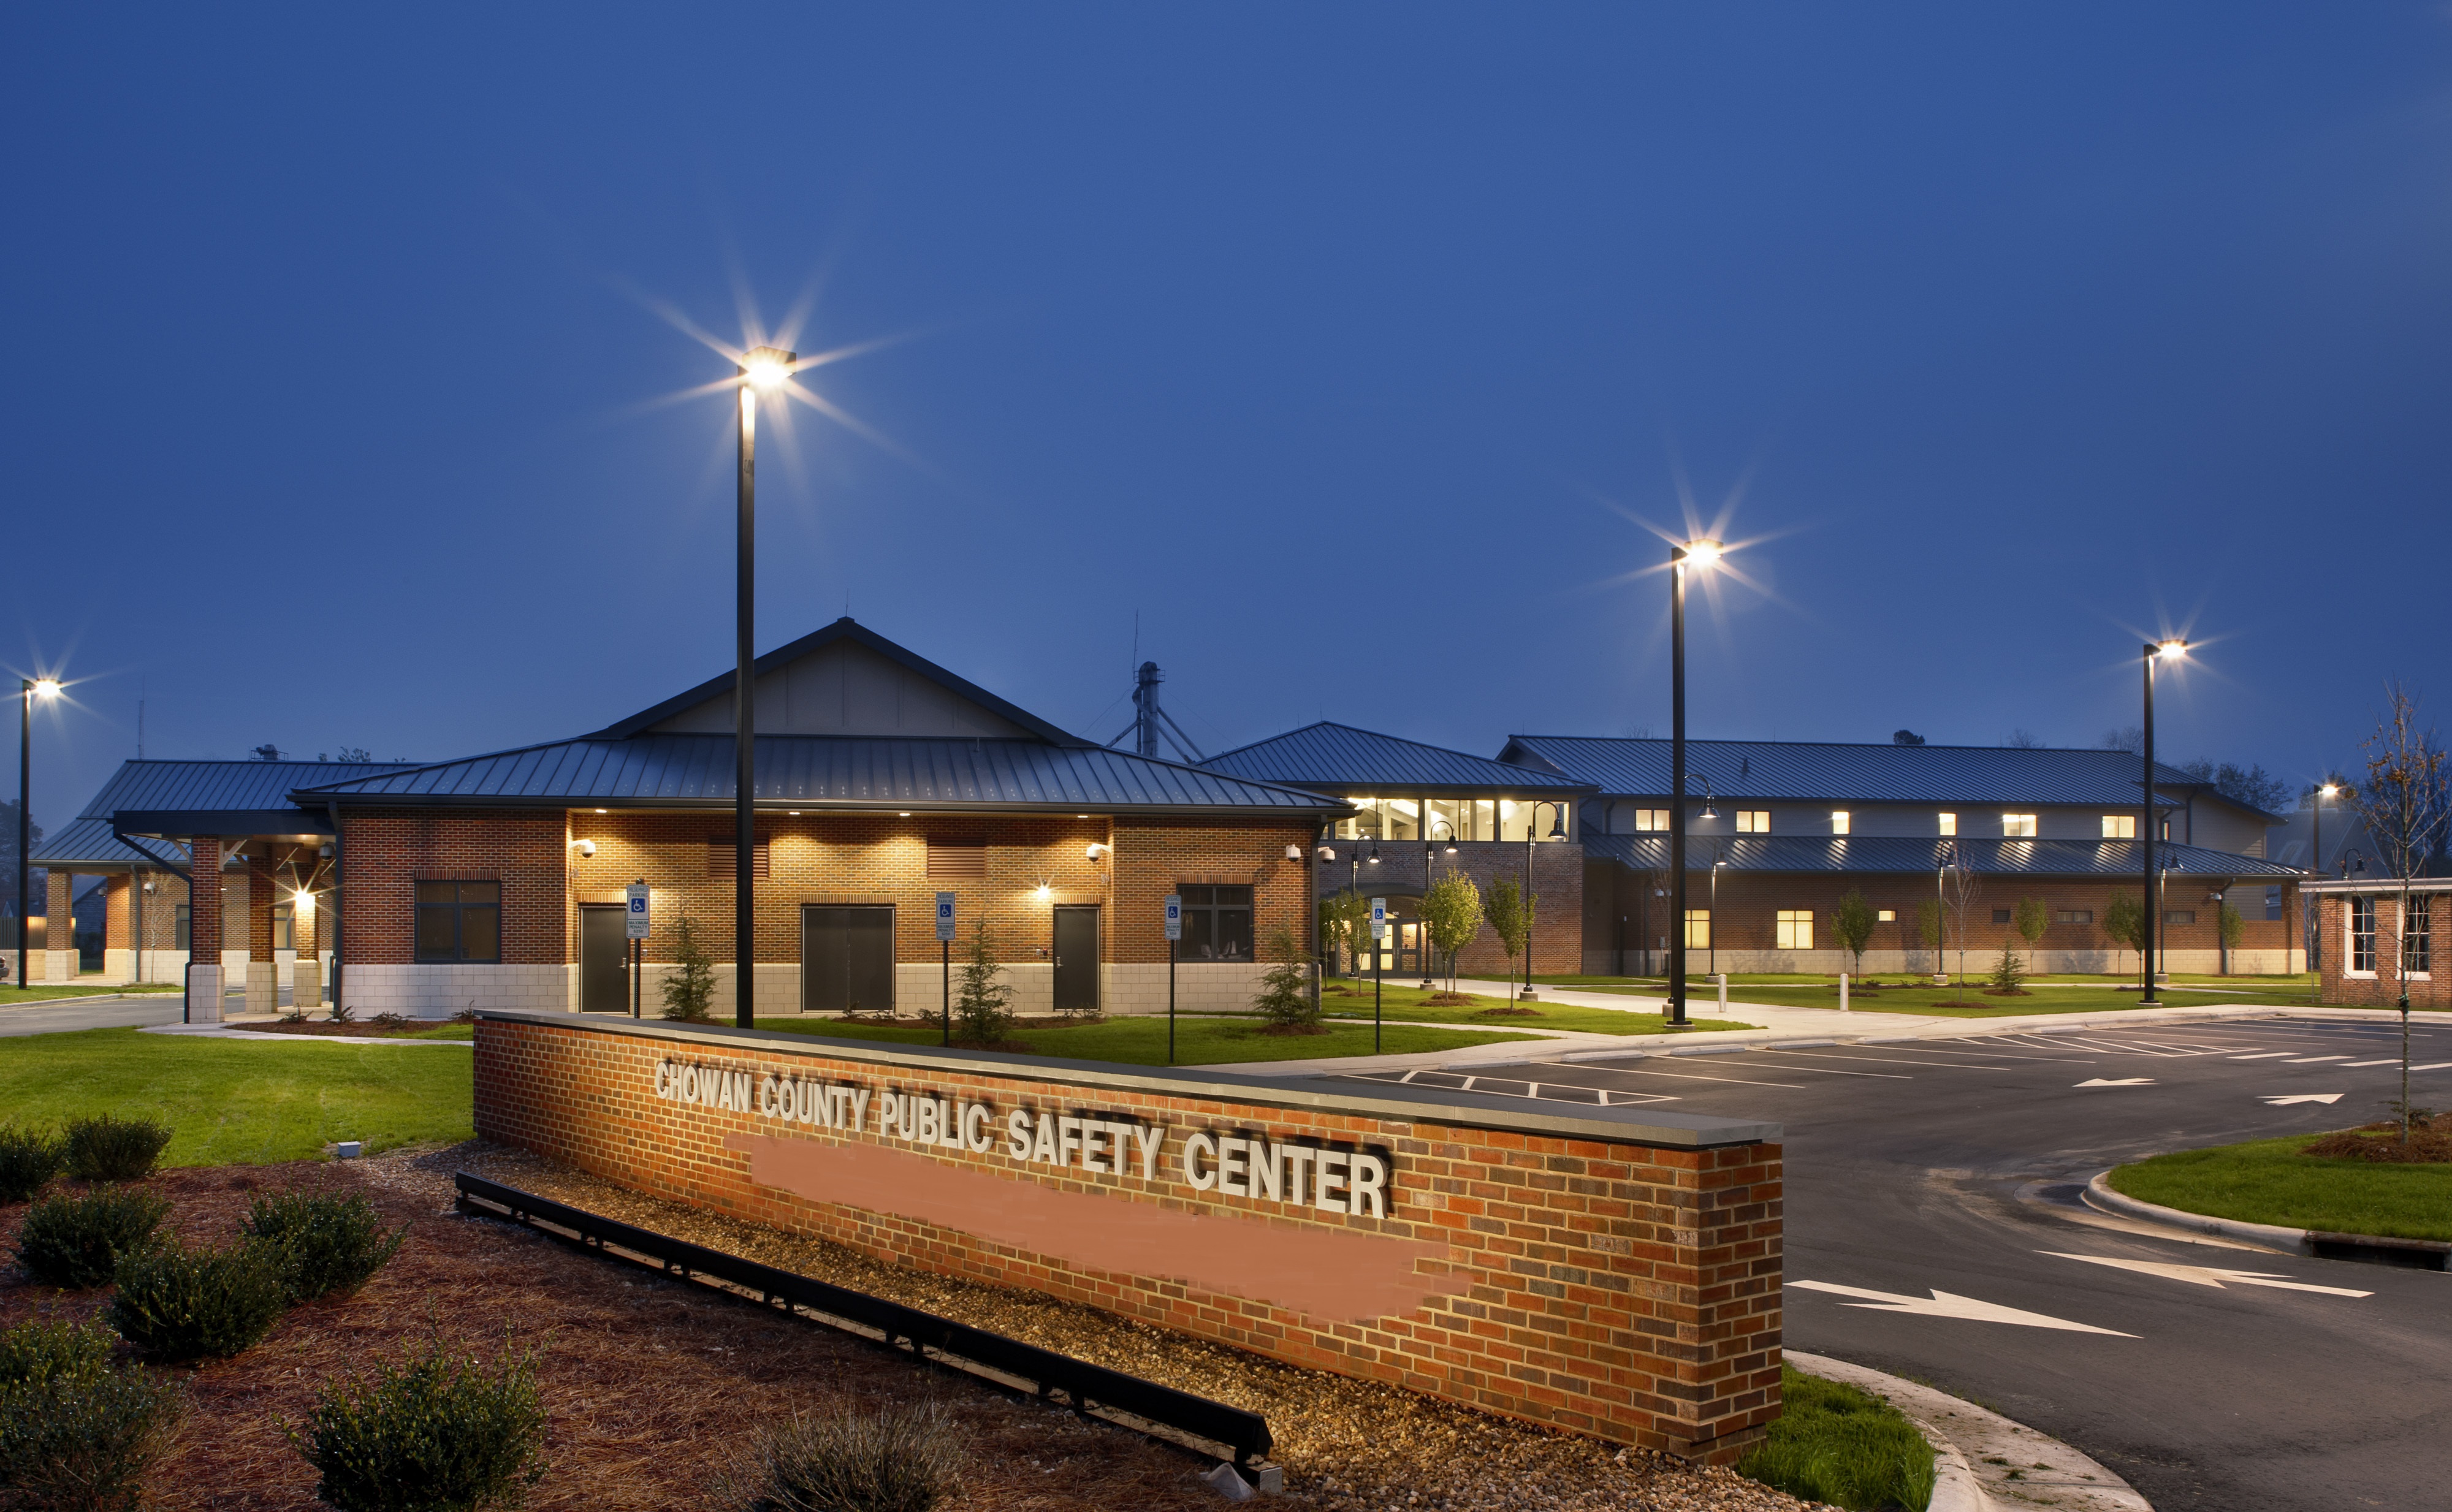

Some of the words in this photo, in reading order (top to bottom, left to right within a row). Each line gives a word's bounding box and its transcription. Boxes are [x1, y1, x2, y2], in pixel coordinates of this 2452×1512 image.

[655, 1062, 752, 1114] CHOWAN
[760, 1076, 871, 1133] COUNTY
[880, 1092, 993, 1154] PUBLIC
[1008, 1109, 1164, 1181] SAFETY
[1184, 1133, 1388, 1219] CENTER
